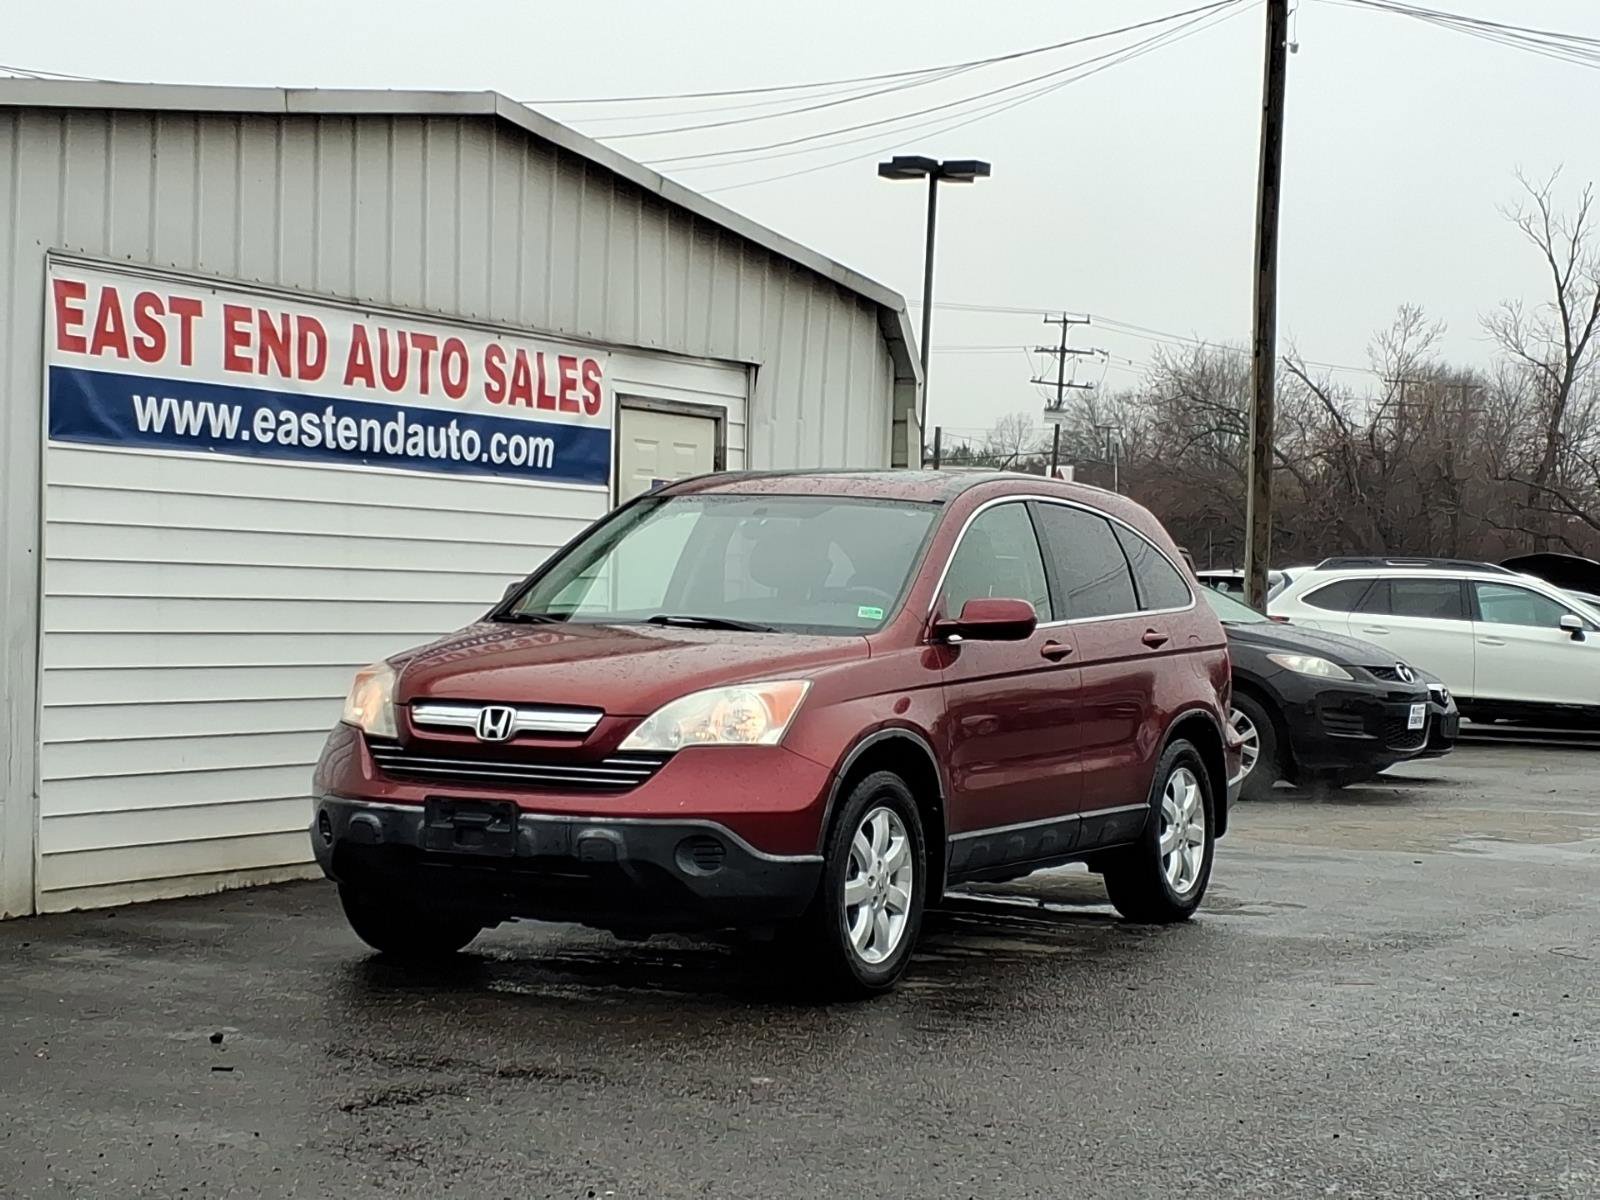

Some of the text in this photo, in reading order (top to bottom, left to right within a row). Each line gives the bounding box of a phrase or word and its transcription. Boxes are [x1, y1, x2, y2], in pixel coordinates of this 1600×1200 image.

[52, 278, 604, 417] EAST END AUTO SALES
[132, 394, 555, 469] www.eastendauto.com
